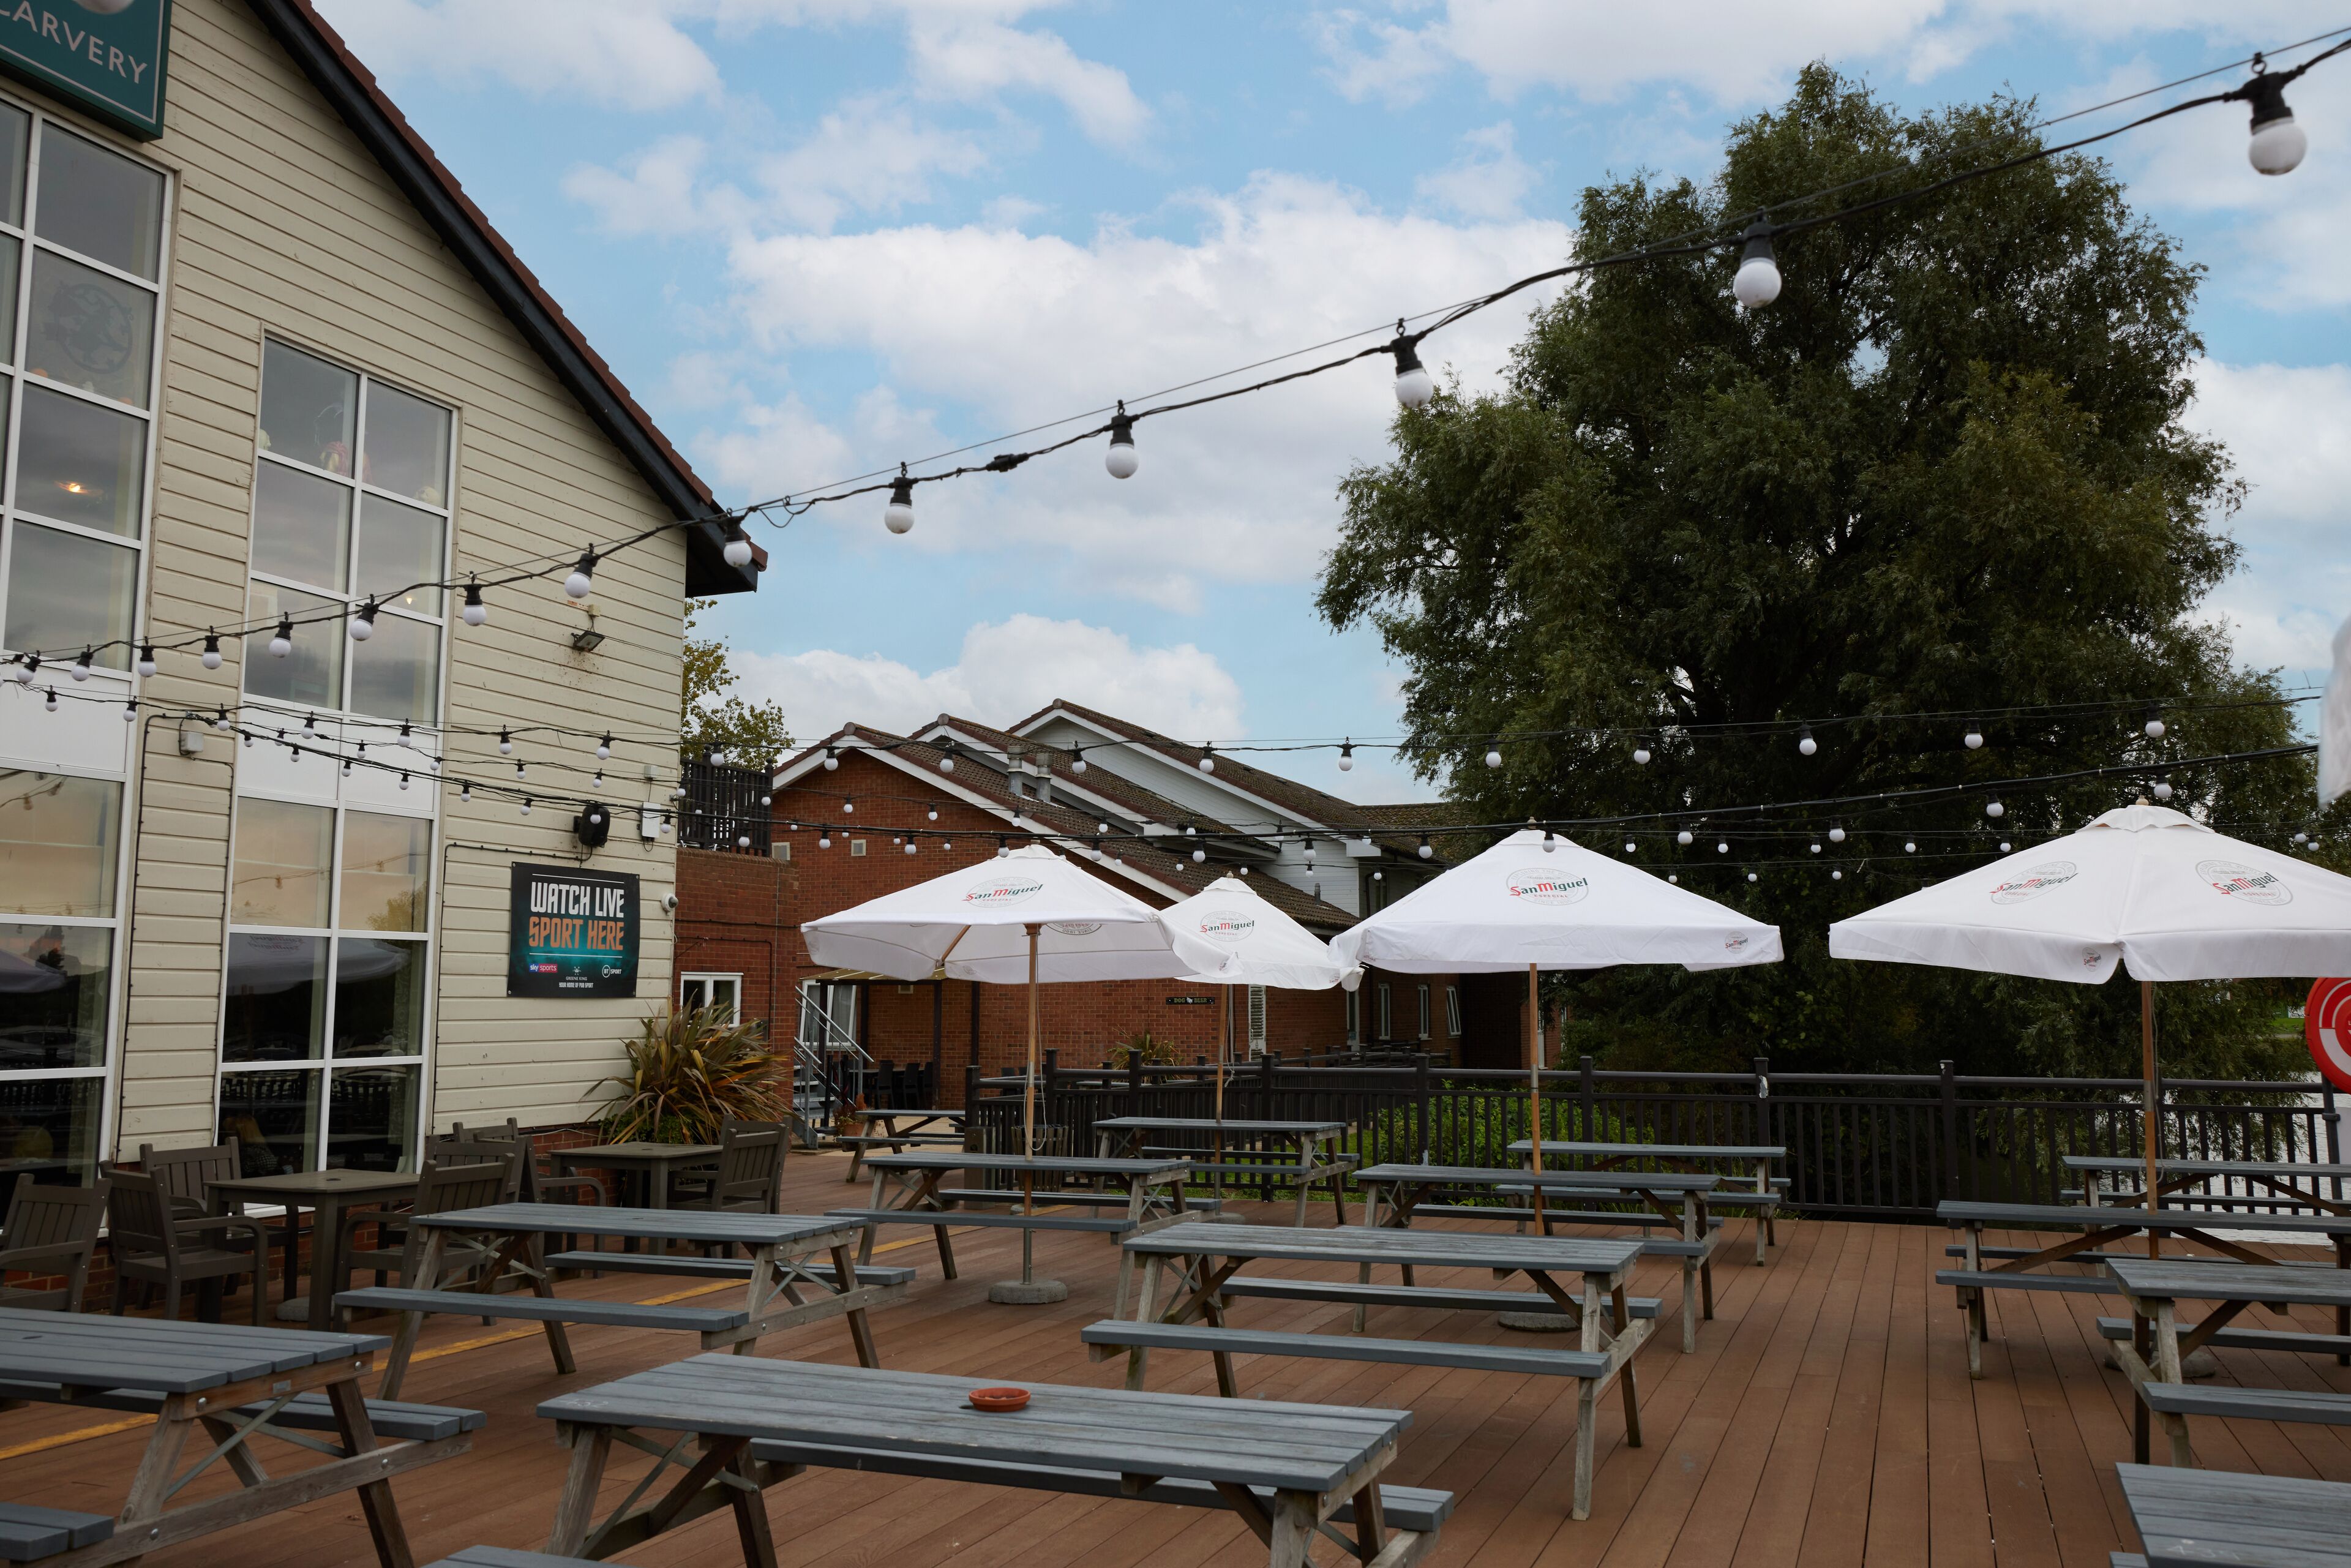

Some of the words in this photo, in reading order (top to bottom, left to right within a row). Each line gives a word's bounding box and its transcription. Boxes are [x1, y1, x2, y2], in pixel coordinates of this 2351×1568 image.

[530, 882, 591, 916] WATCH
[594, 887, 624, 918] LIVE
[529, 916, 583, 949] SPORT
[587, 920, 624, 951] HERE
